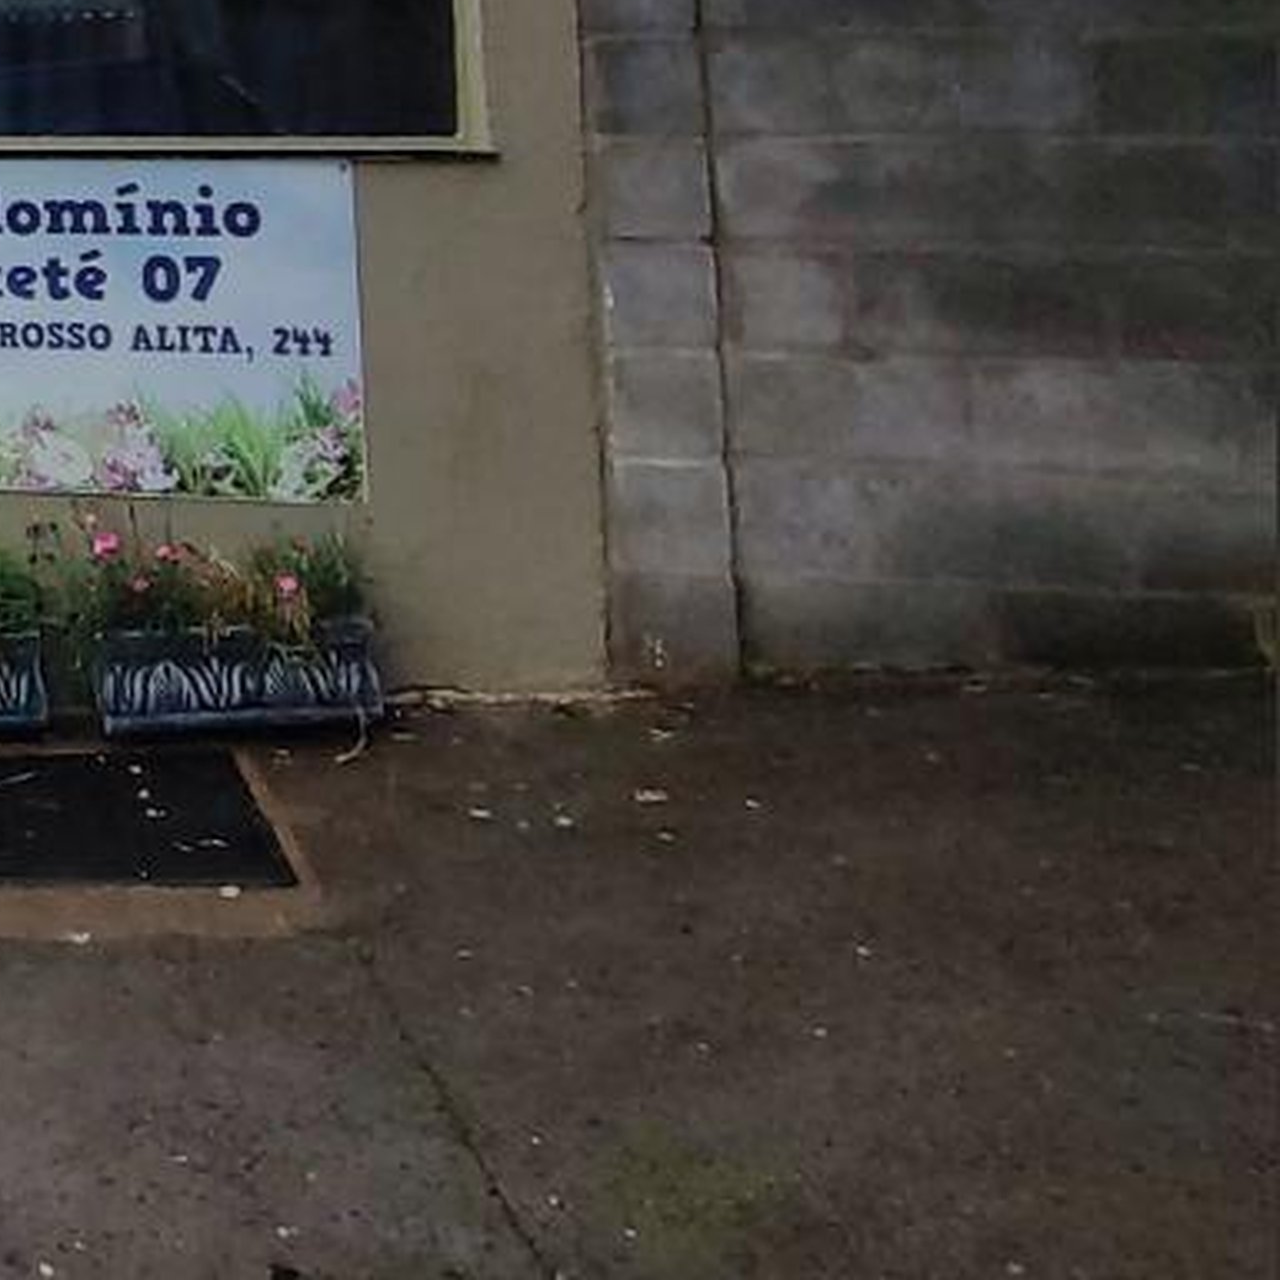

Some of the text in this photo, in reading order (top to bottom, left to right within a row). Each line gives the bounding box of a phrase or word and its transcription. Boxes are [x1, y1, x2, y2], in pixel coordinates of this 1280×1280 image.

[143, 255, 221, 302] 07
[131, 324, 254, 361] ALITA,
[273, 327, 333, 357] 244
